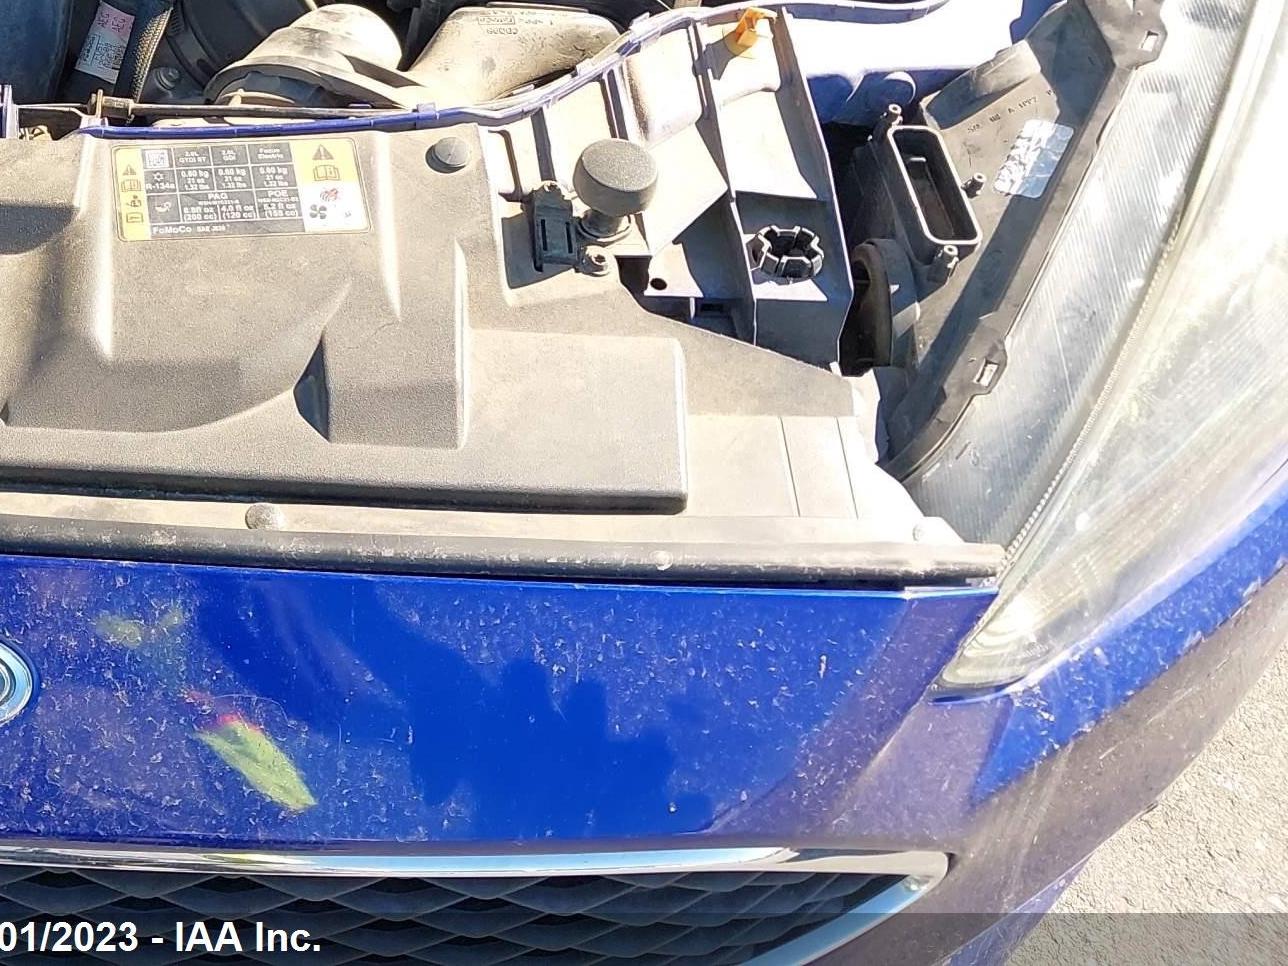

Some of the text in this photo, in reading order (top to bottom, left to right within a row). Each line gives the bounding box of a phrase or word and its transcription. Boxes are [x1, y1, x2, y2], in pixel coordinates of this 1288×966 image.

[199, 170, 210, 178] kg
[236, 168, 246, 176] kg
[278, 166, 288, 174] kg
[284, 210, 299, 218] cc)
[152, 226, 192, 234] FoMoCo
